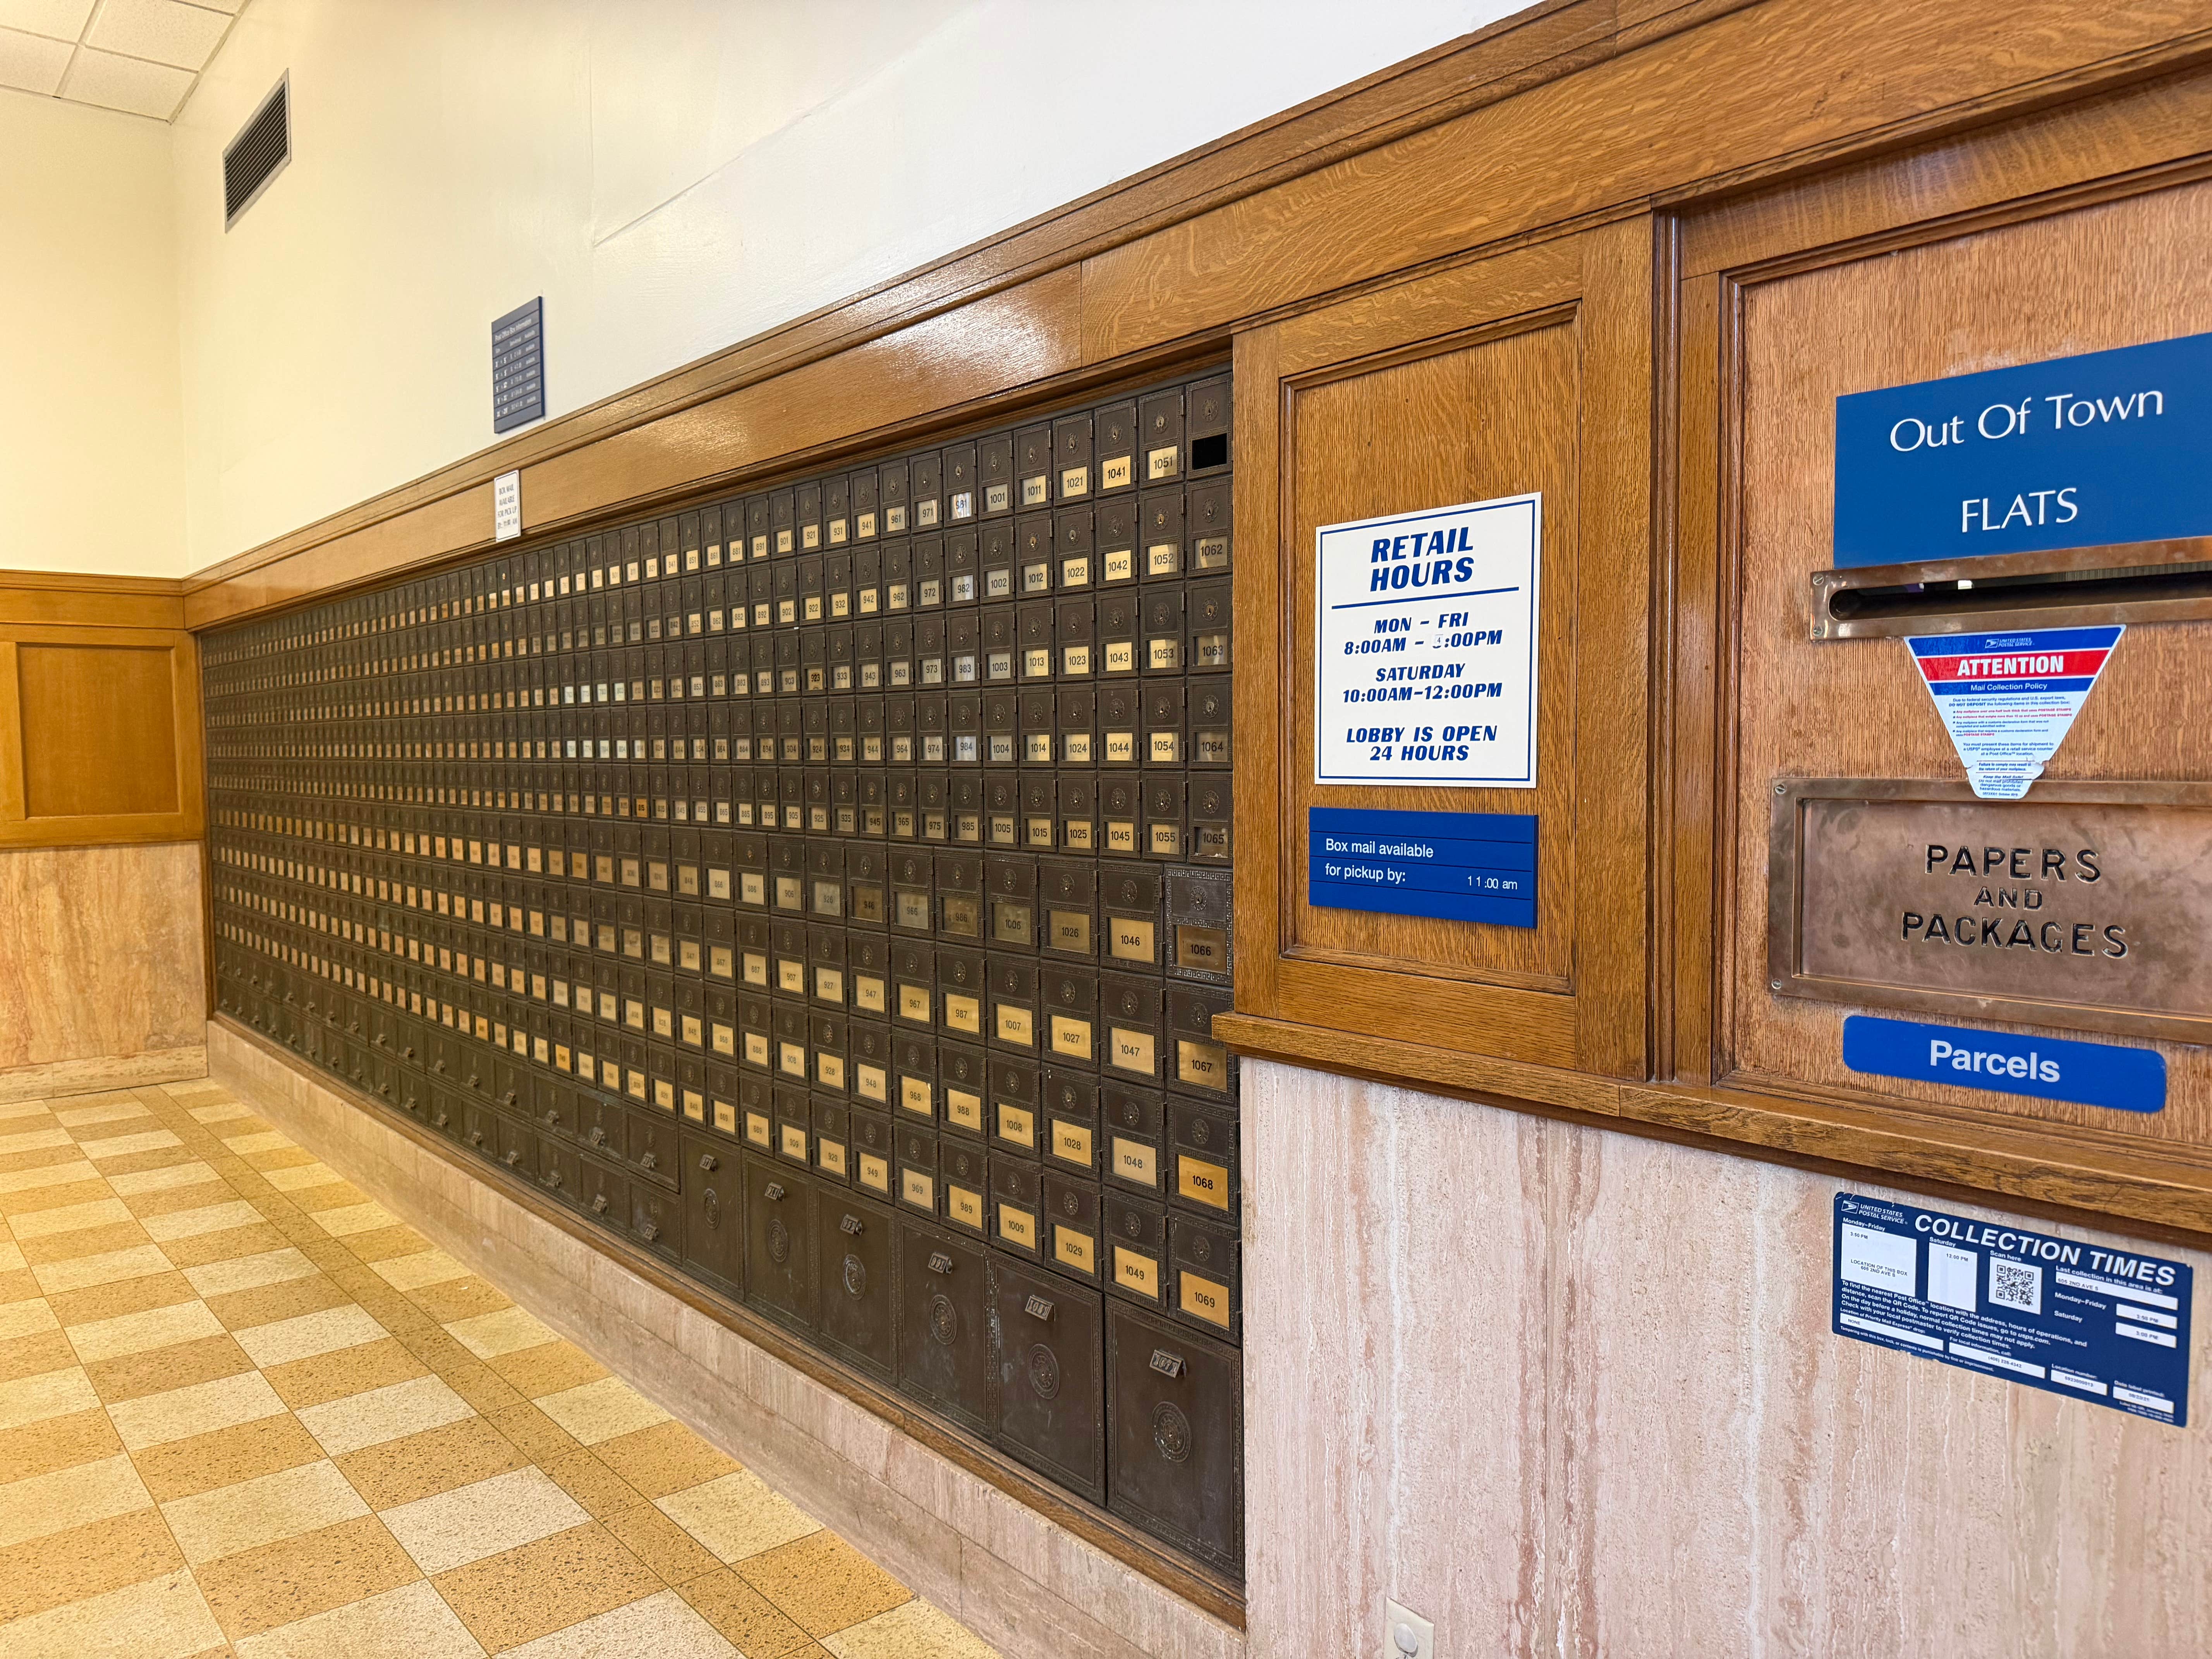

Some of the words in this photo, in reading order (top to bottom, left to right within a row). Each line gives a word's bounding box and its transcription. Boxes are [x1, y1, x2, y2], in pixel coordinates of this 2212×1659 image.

[1890, 415, 1964, 452] Out
[1978, 397, 2032, 439] Of
[2045, 390, 2163, 429] Town
[1154, 456, 1173, 470] 1051
[1108, 466, 1125, 479] 1041
[1066, 476, 1083, 488] 1021
[1027, 484, 1041, 496] 1011
[990, 492, 1005, 503] 1001
[922, 507, 933, 517] 971
[1961, 487, 2078, 533] FLATS
[862, 520, 871, 530] 941
[807, 531, 816, 539] 921
[756, 543, 765, 551] 891
[1201, 544, 1223, 557] 1062
[1370, 527, 1473, 563] RETAIL
[1154, 553, 1174, 565] 1052
[1108, 560, 1127, 572] 1042
[1029, 572, 1043, 584] 1012
[1067, 567, 1084, 578] 1022
[1370, 557, 1474, 591] HOURS
[1374, 617, 1411, 633] MON
[1438, 612, 1468, 629] FRI
[1203, 645, 1223, 656] 1063
[1344, 637, 1406, 655] 8:00AM
[1109, 652, 1129, 663] 1043
[1154, 648, 1174, 659] 1053
[1029, 656, 1044, 666] 1013
[1068, 655, 1086, 665] 1023
[1957, 656, 2064, 675] ATTENTION
[992, 662, 1008, 671] 1003
[1376, 663, 1465, 681] SATURDAY
[1343, 682, 1502, 702] 10:00AM-12:00PM
[1346, 727, 1404, 742] LOBBY
[1414, 727, 1432, 742] IS
[1443, 725, 1497, 741] OPEN
[1031, 743, 1046, 752] 1014
[1069, 743, 1087, 753] 1024
[1109, 742, 1129, 752] 1044
[1154, 741, 1174, 751] 1054
[1202, 741, 1224, 752] 1064
[1370, 747, 1392, 760] 24
[1401, 745, 1469, 760] HOURS
[962, 821, 974, 831] 985
[1032, 828, 1047, 837] 1015
[1070, 829, 1087, 839] 1025
[1110, 830, 1130, 841] 1045
[1156, 831, 1175, 842] 1055
[1203, 833, 1224, 844] 1065
[1326, 838, 1348, 852] Box
[1352, 841, 1375, 854] mail
[1379, 843, 1433, 858] available
[1925, 844, 2101, 883] PAPERS
[1326, 864, 1341, 876] for
[1344, 866, 1383, 882] pickup
[1388, 868, 1406, 884] by:
[1503, 881, 1517, 890] am
[1974, 886, 2042, 910] AND
[1005, 919, 1021, 930] 1006
[1061, 926, 1079, 938] 1026
[1901, 912, 2128, 959] PACKAGES
[1121, 935, 1140, 946] 1046
[1190, 944, 1211, 956] 1066
[866, 989, 876, 998] 947
[956, 1009, 967, 1019] 987
[1005, 1019, 1021, 1031] 1007
[1063, 1032, 1080, 1043] 1027
[1121, 1044, 1140, 1056] 1047
[1192, 1060, 1212, 1072] 1067
[1930, 1039, 2060, 1083] Parcels
[957, 1105, 969, 1116] 988
[1006, 1120, 1022, 1132] 1008
[1064, 1137, 1081, 1150] 1028
[1124, 1154, 1143, 1168] 1048
[867, 1167, 878, 1178] 949
[1192, 1175, 1213, 1190] 1068
[1860, 1204, 1882, 1212] UNITED
[1859, 1210, 1879, 1219] POSTAL
[1008, 1220, 1024, 1233] 1009
[1930, 1237, 1956, 1248] Saturday
[1065, 1243, 1082, 1256] 1029
[1915, 1214, 2081, 1265] COLLECTION
[2090, 1251, 2176, 1286] TIMES
[1851, 1259, 1875, 1268] LOCATION
[2007, 1253, 2021, 1262] here
[1125, 1265, 1144, 1280] 1049
[2056, 1265, 2070, 1274] Last
[2072, 1270, 2104, 1281] collection
[1194, 1292, 1215, 1307] 1069
[1028, 1300, 1048, 1316] 1081
[1872, 1288, 1892, 1298] nearest
[1930, 1303, 1953, 1313] location
[1955, 1309, 1968, 1317] with
[1981, 1316, 2007, 1328] address,
[2009, 1322, 2027, 1332] hours
[2036, 1330, 2073, 1344] operations,
[2054, 1311, 2083, 1322] Saturday
[1153, 1354, 1178, 1373] 1071
